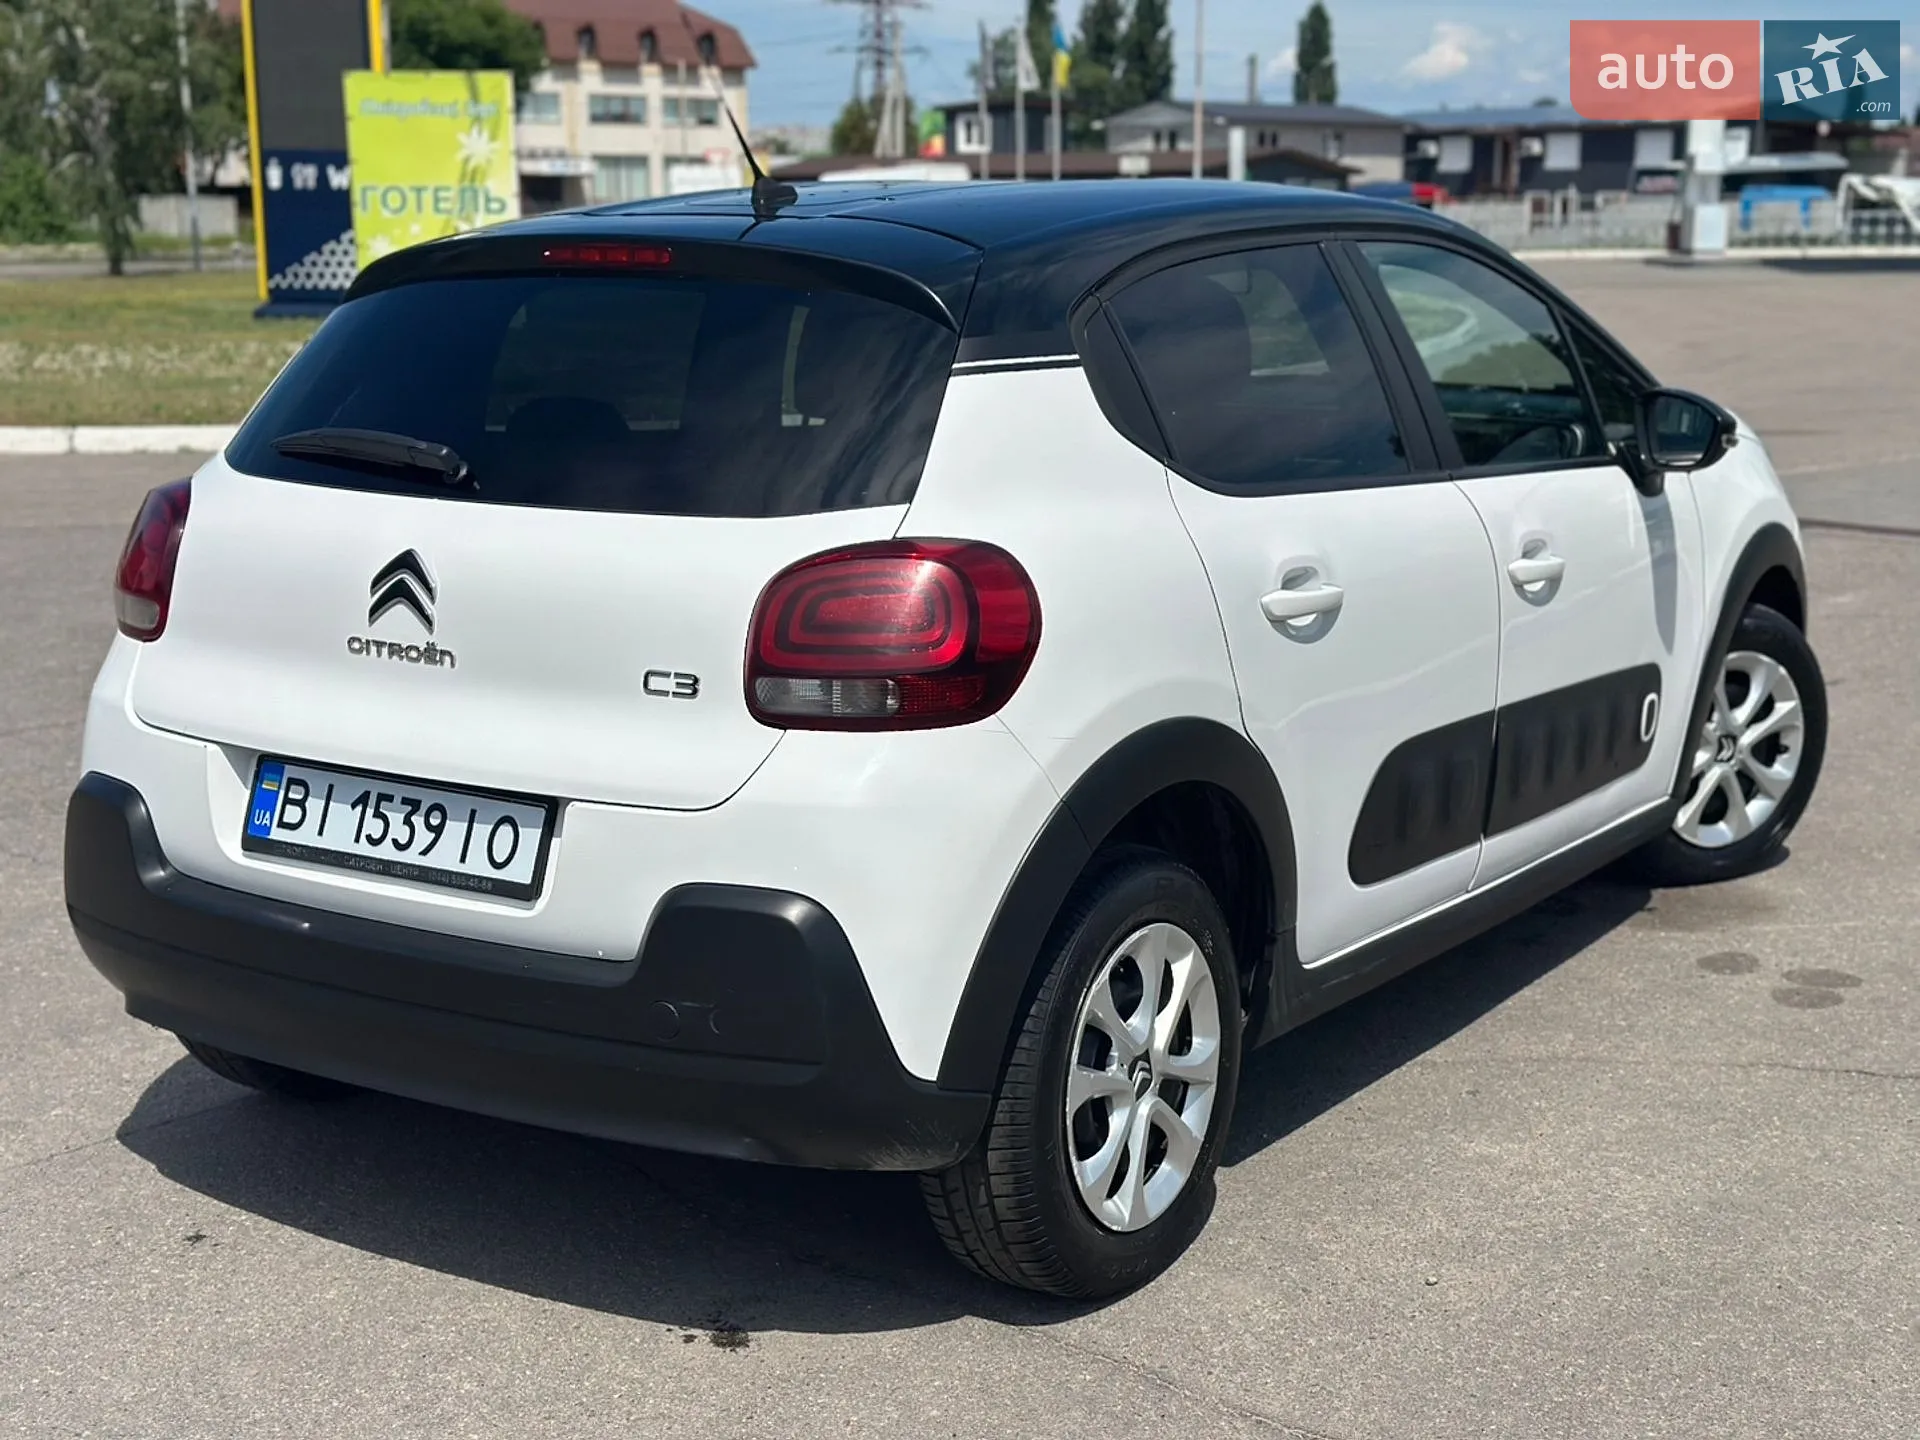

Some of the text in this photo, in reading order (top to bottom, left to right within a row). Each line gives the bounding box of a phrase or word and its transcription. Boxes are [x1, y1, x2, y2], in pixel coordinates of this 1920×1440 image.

[360, 184, 508, 216] ГОТЕЛЬ
[642, 669, 700, 700] C3
[254, 808, 271, 828] UA
[276, 776, 334, 837] BI
[350, 789, 448, 857] 1539
